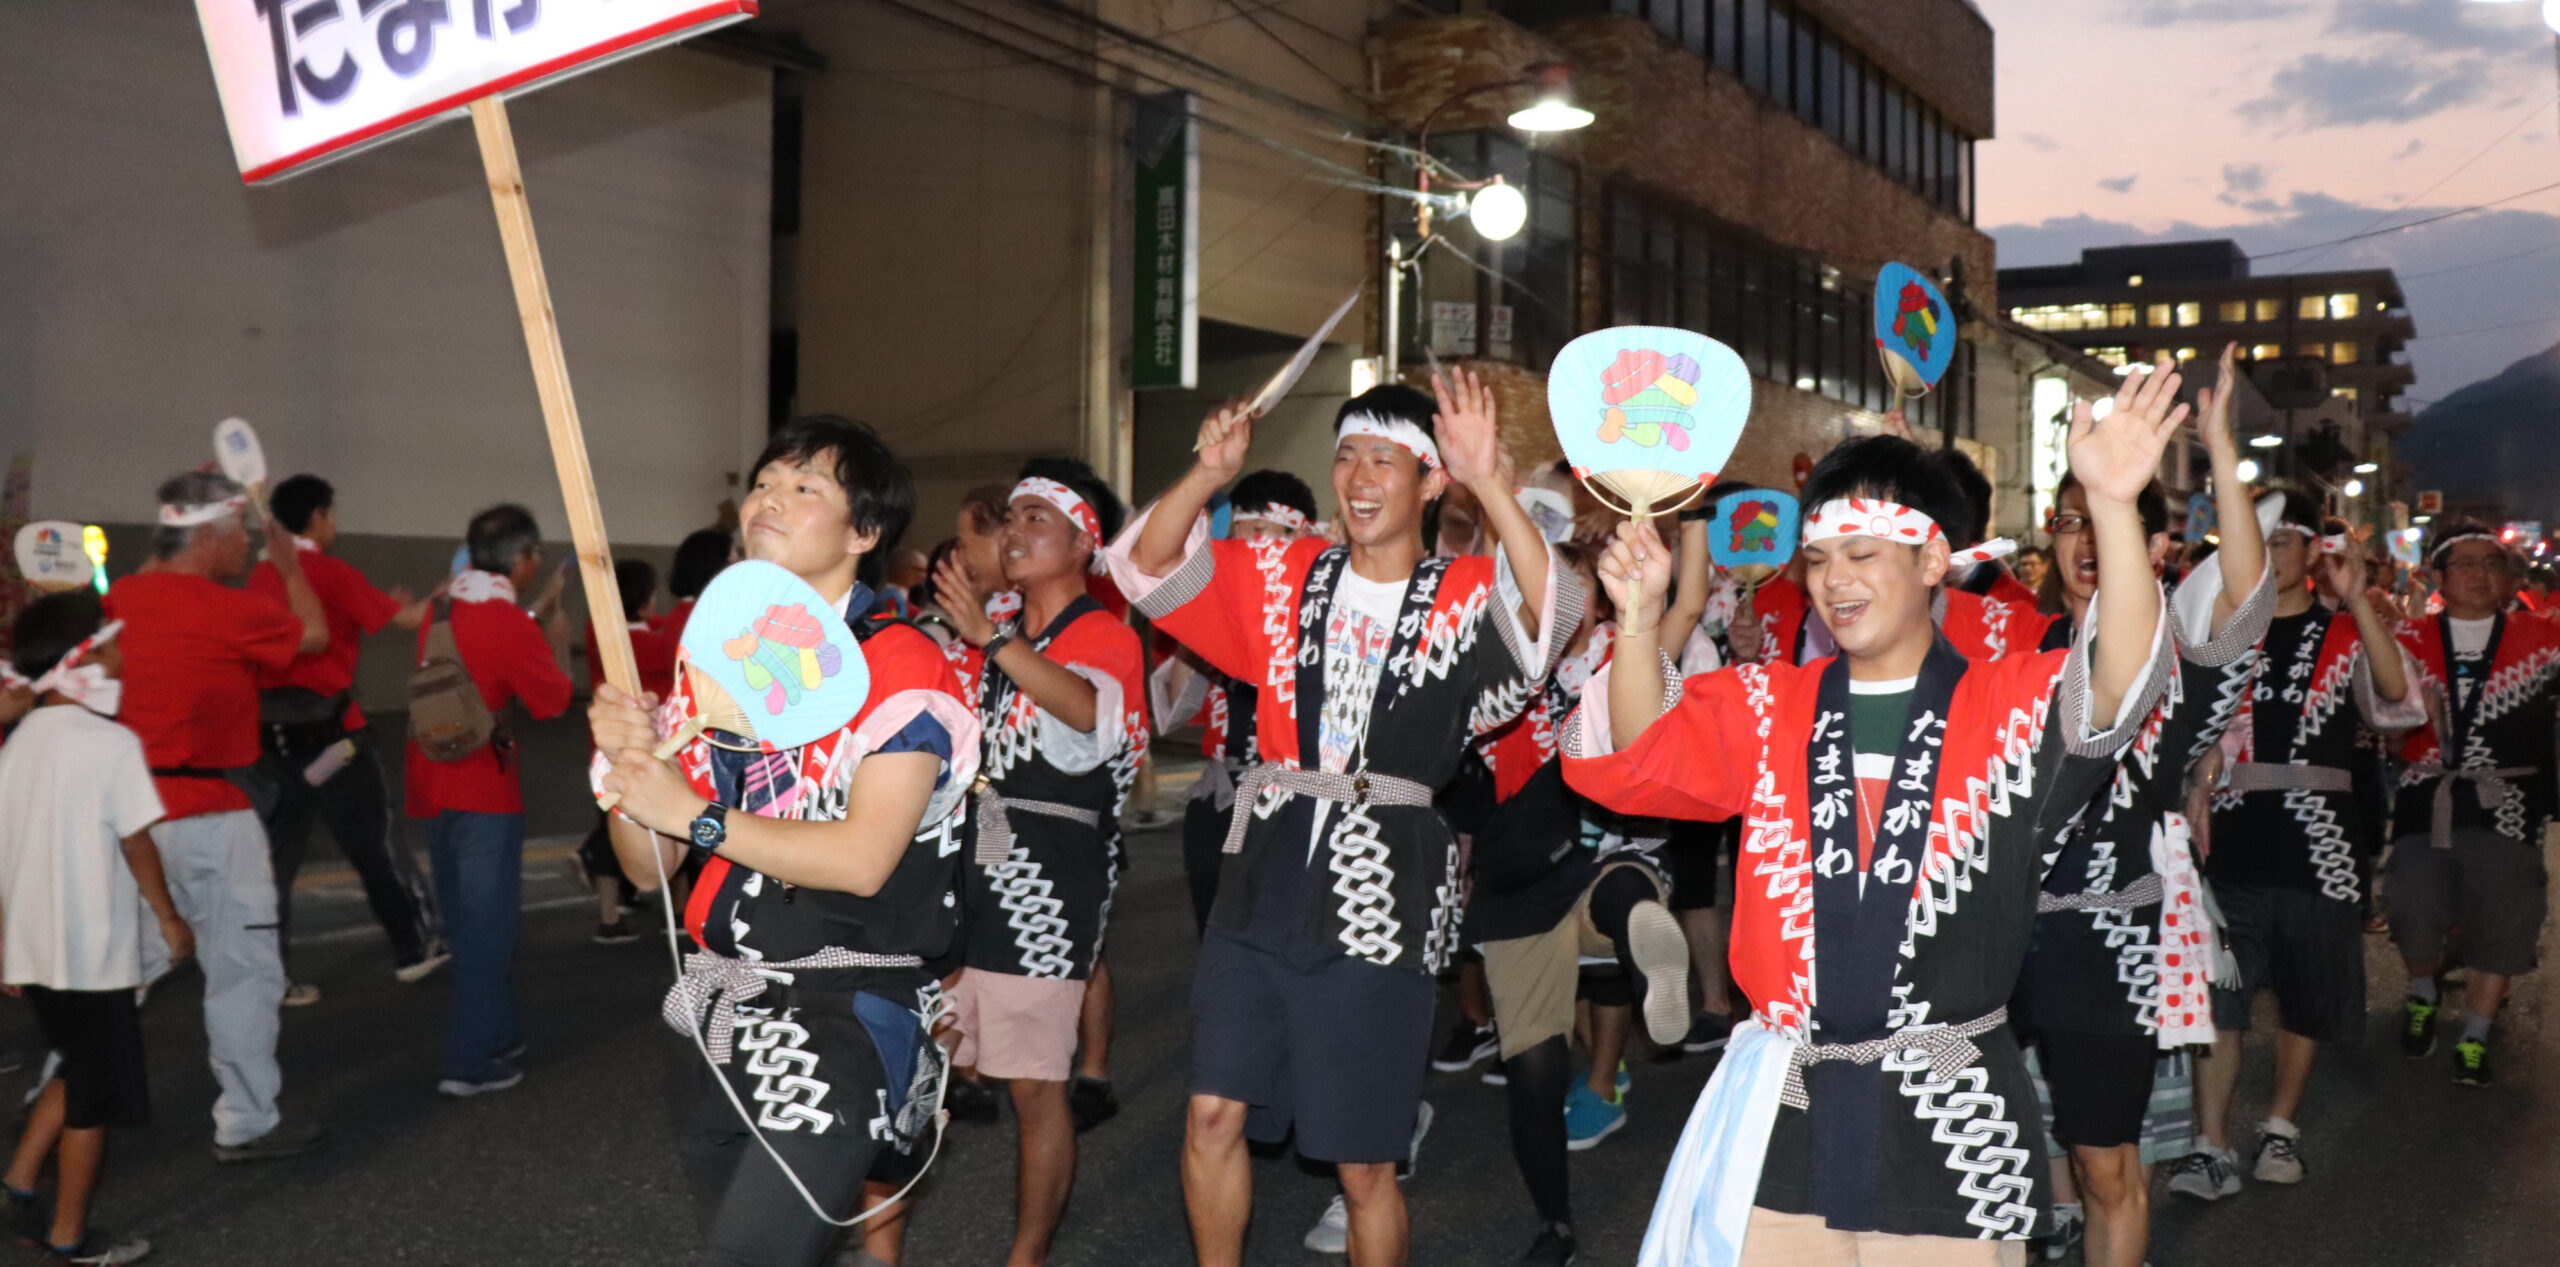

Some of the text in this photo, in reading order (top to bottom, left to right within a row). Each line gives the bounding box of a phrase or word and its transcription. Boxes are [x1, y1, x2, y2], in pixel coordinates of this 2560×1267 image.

[2281, 621, 2324, 704] たまがわ
[1811, 711, 1854, 879] たまがわ
[1874, 709, 1947, 884] たまがわ
